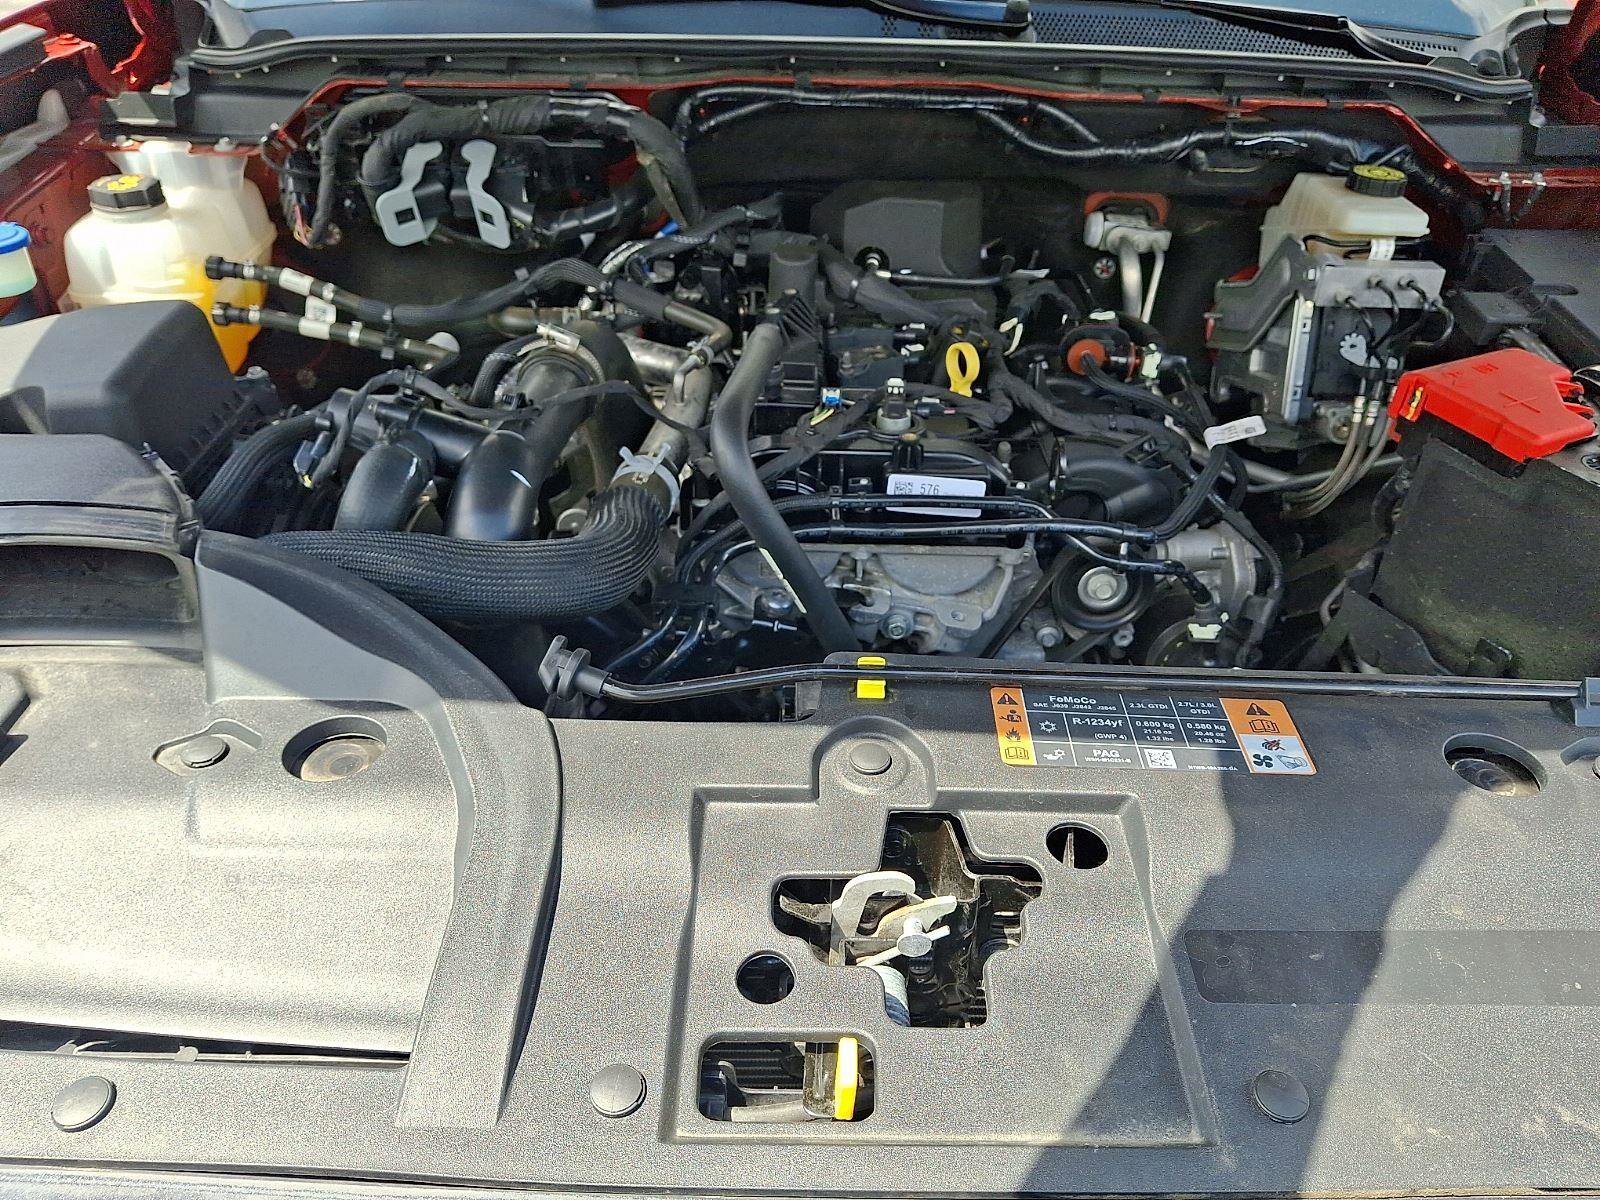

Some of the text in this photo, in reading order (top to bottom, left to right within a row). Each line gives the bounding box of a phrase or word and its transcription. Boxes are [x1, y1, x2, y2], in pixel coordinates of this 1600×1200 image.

[920, 484, 940, 494] 576
[1049, 696, 1096, 704] FoMoCo
[1072, 718, 1123, 728] R-1234yf
[1162, 722, 1176, 730] kg
[1214, 724, 1226, 732] kg
[1092, 750, 1120, 758] PAG
